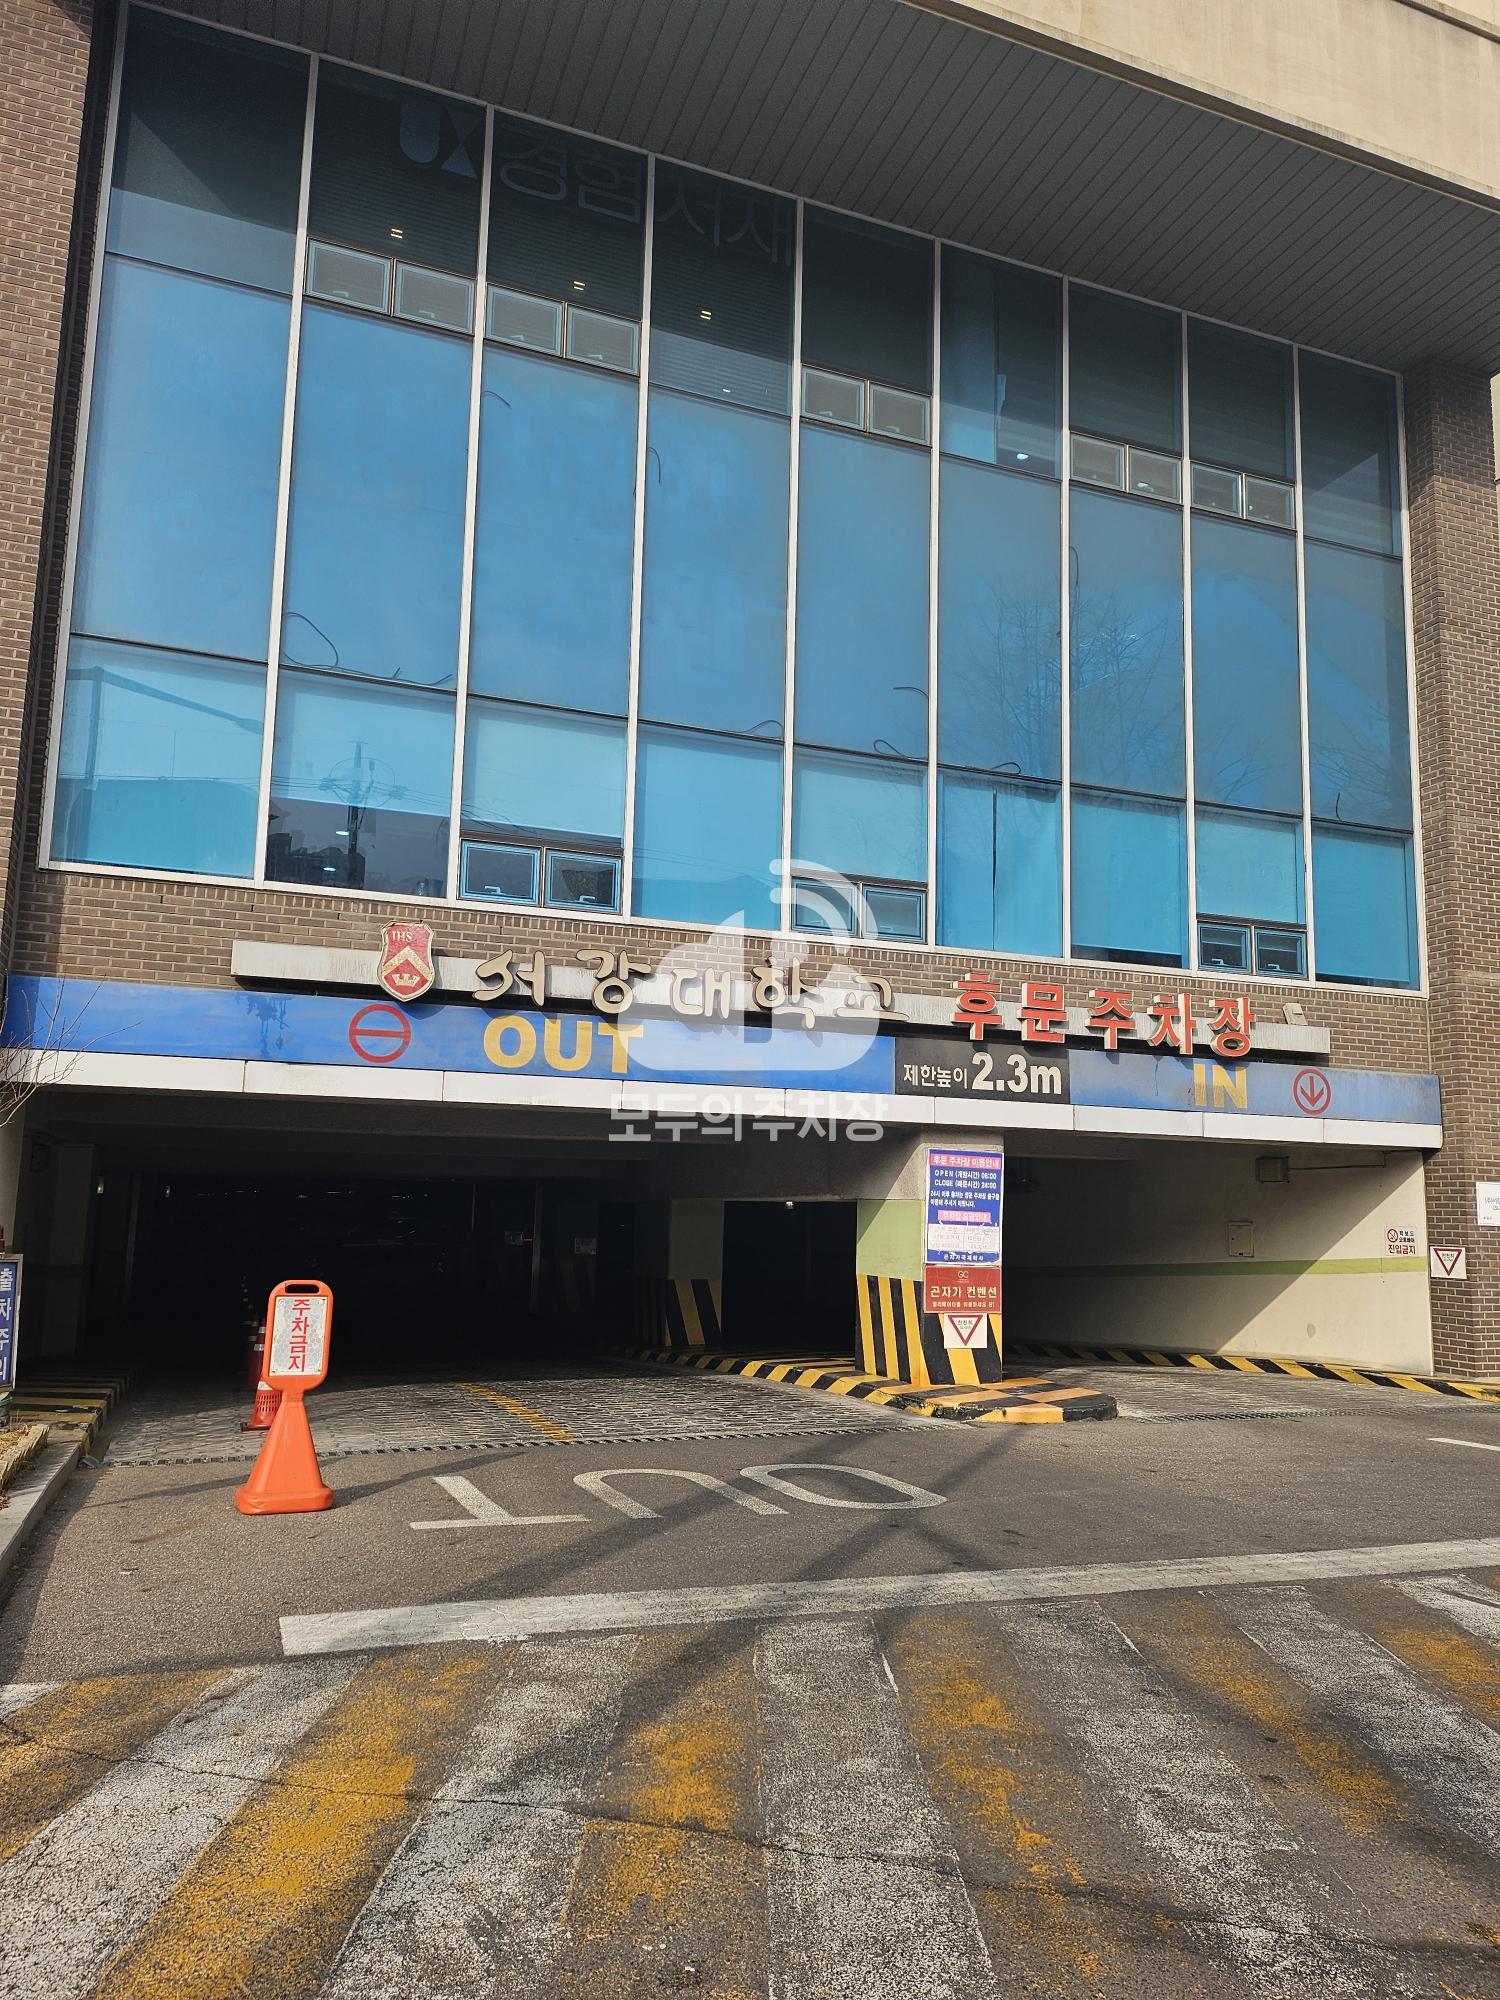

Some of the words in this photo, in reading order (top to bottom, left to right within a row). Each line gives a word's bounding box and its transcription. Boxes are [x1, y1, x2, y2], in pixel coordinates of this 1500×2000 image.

[391, 930, 413, 942] IHS
[472, 949, 910, 1029] 서강대학교
[951, 972, 1256, 1057] 후문주차장
[483, 1015, 644, 1074] OUT
[903, 1064, 968, 1090] 제한높이
[971, 1051, 1062, 1095] 2.3m
[1193, 1062, 1247, 1109] IN
[933, 1155, 947, 1165] 후문
[949, 1156, 971, 1167] 주차장
[934, 1169, 954, 1177] OPEN
[934, 1179, 953, 1187] CLOSE
[1388, 1244, 1416, 1255] 진입금지
[930, 1286, 962, 1298] 곤자가
[966, 1286, 997, 1298] 컨벤션
[288, 1299, 311, 1372] 주차금지
